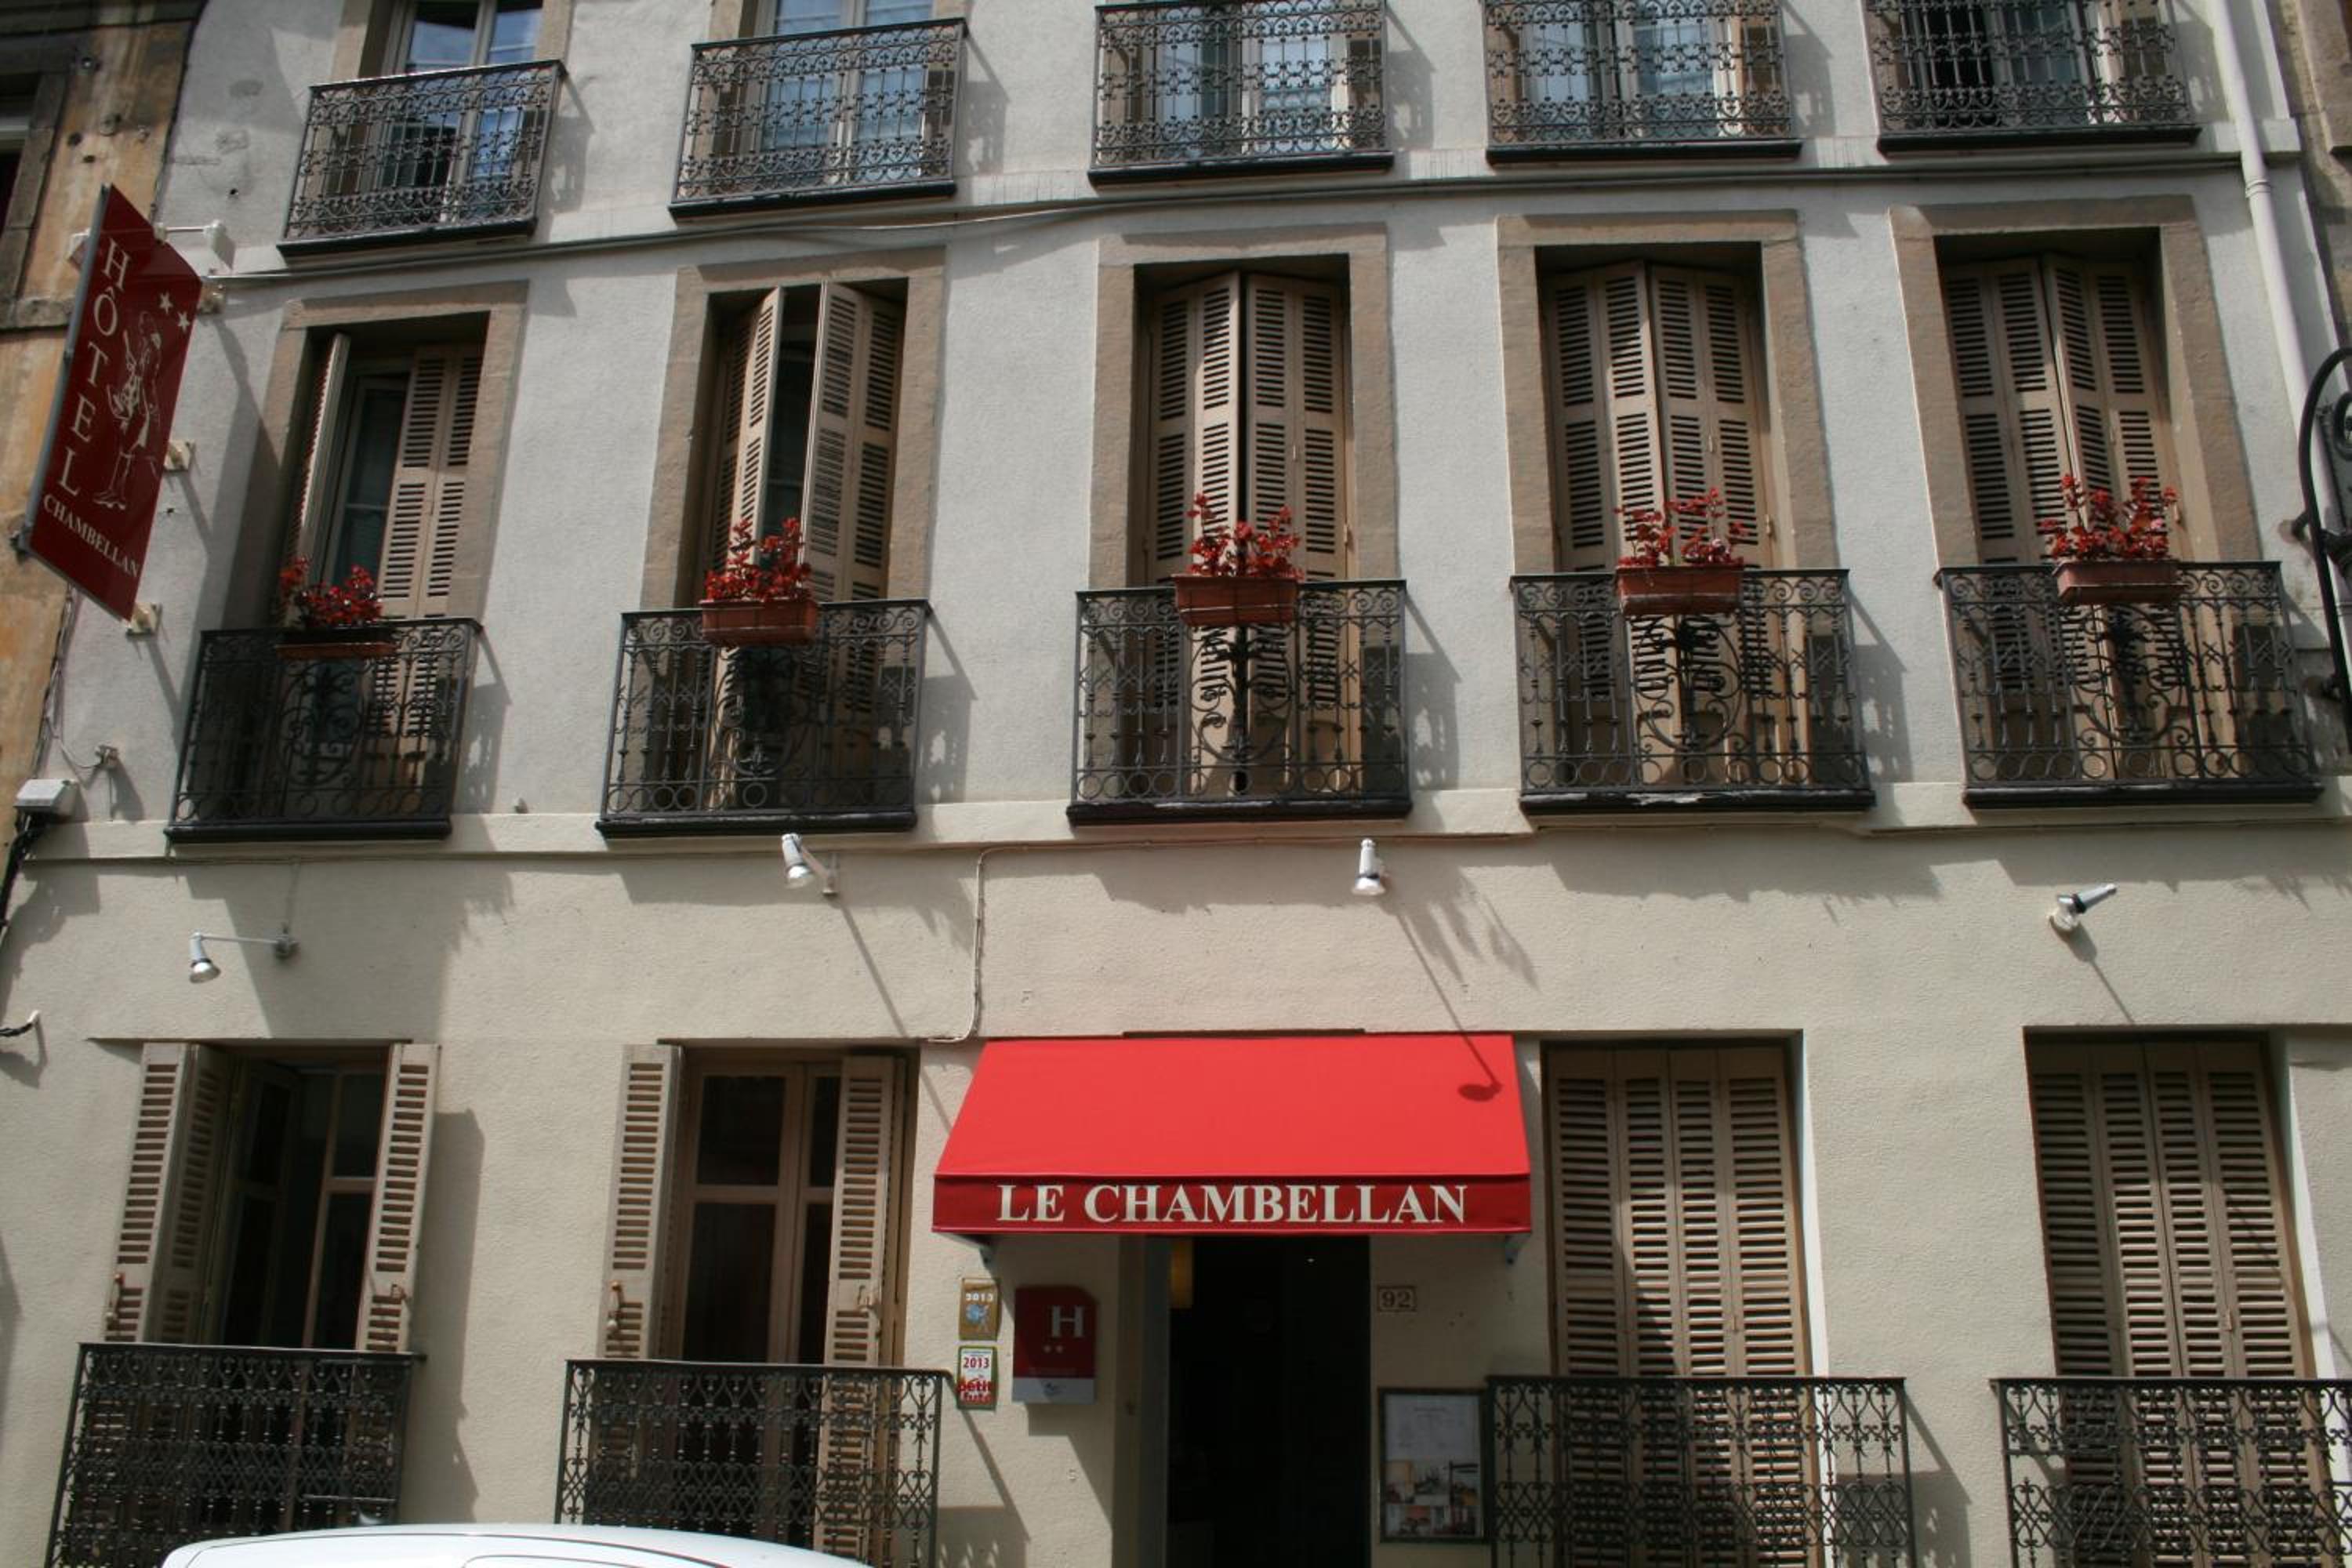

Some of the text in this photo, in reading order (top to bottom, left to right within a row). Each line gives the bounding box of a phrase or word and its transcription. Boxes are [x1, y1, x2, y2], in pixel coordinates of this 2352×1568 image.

[58, 238, 131, 497] HÔTEL
[43, 494, 140, 579] CHAMBELLAN
[996, 1184, 1468, 1224] LE CHAMBELLAN
[1381, 1290, 1411, 1308] 92
[1051, 1305, 1086, 1338] H
[964, 1357, 990, 1369] 2013
